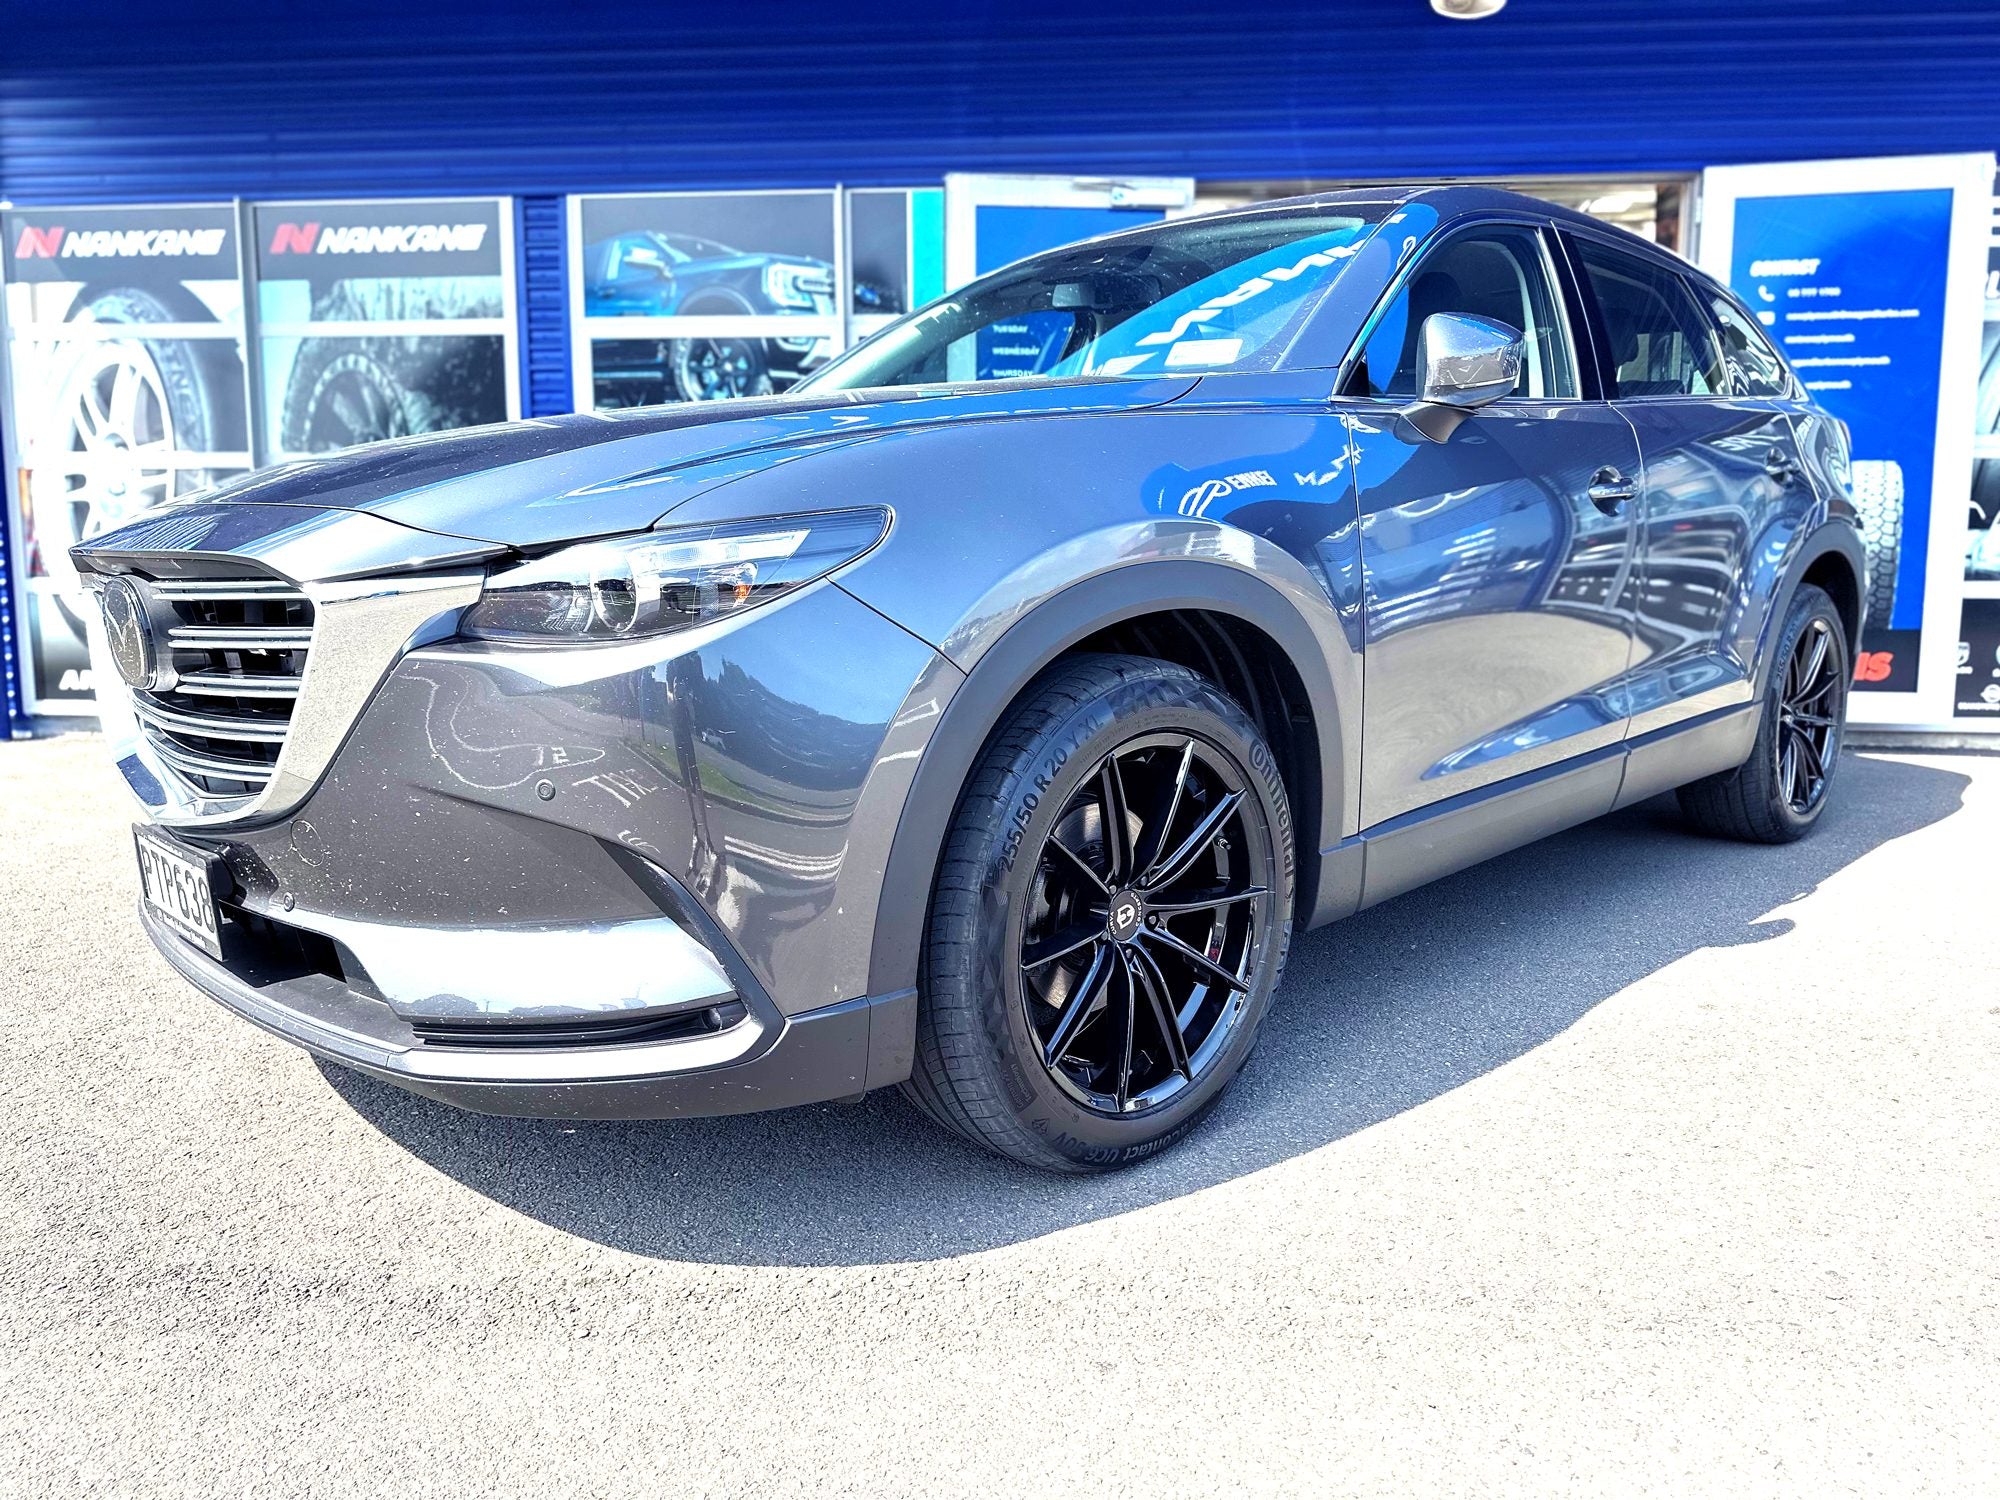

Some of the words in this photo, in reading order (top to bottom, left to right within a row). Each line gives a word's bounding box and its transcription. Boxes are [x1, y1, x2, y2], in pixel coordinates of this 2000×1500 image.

[992, 368, 1034, 378] THURSDAY
[999, 792, 1039, 873] 255/50
[1033, 773, 1052, 794] R
[1044, 747, 1068, 778] 20
[1065, 730, 1081, 750] Y
[1079, 713, 1105, 741] XL
[1248, 738, 1295, 882] Continental
[140, 843, 216, 934] PTP638
